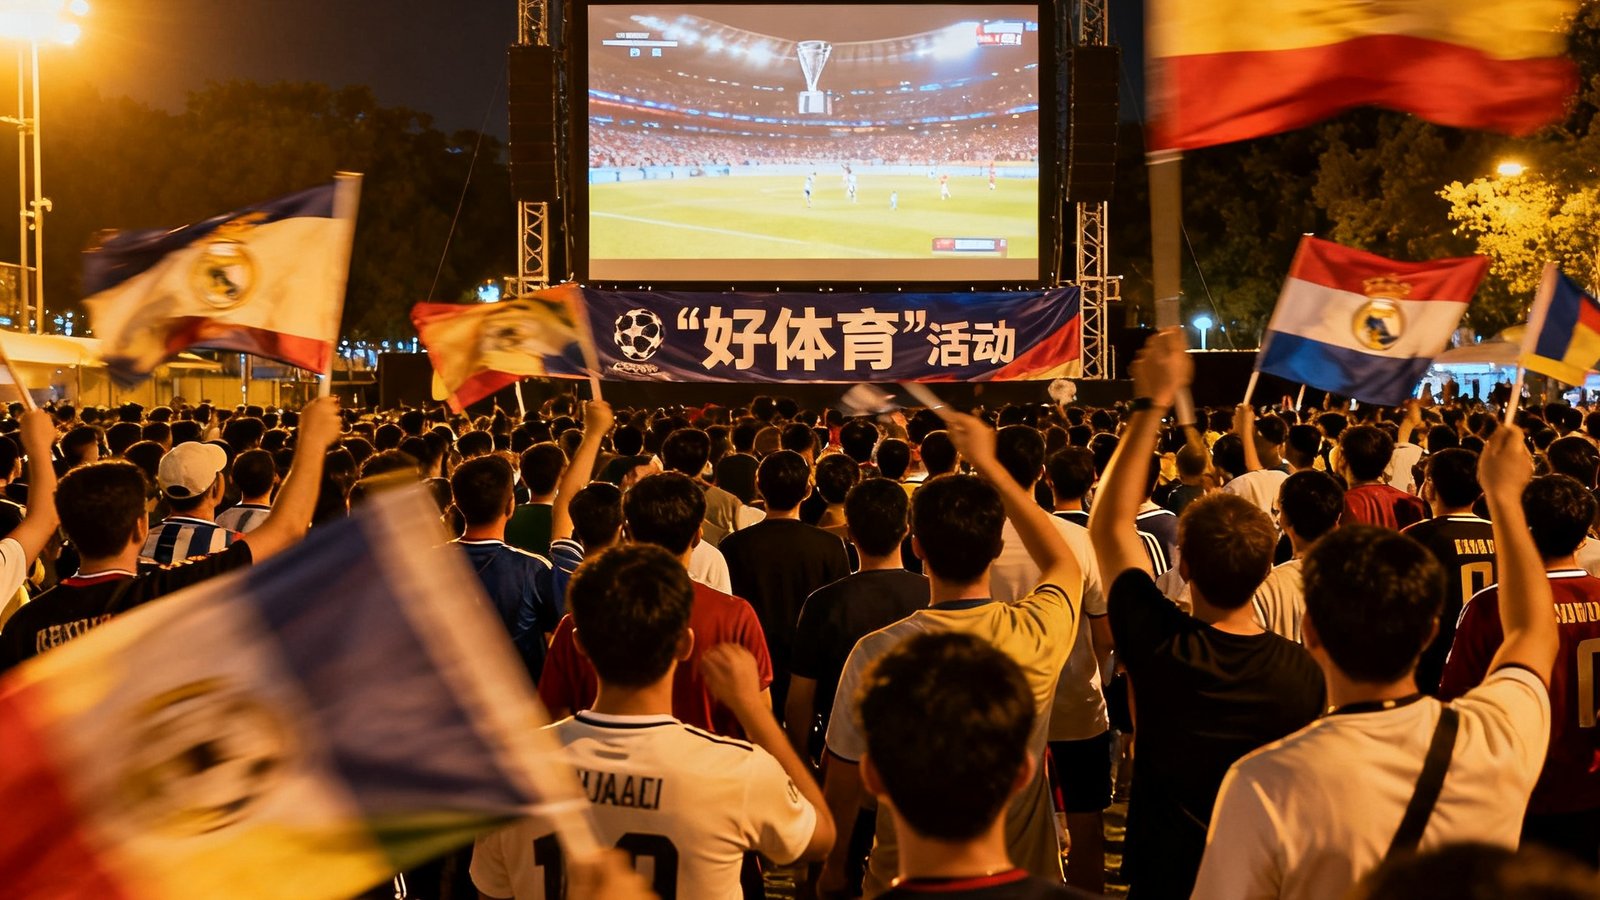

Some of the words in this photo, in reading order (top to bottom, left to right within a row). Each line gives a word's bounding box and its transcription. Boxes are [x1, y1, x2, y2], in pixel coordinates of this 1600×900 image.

[676, 305, 1016, 371] “好体育”活动
